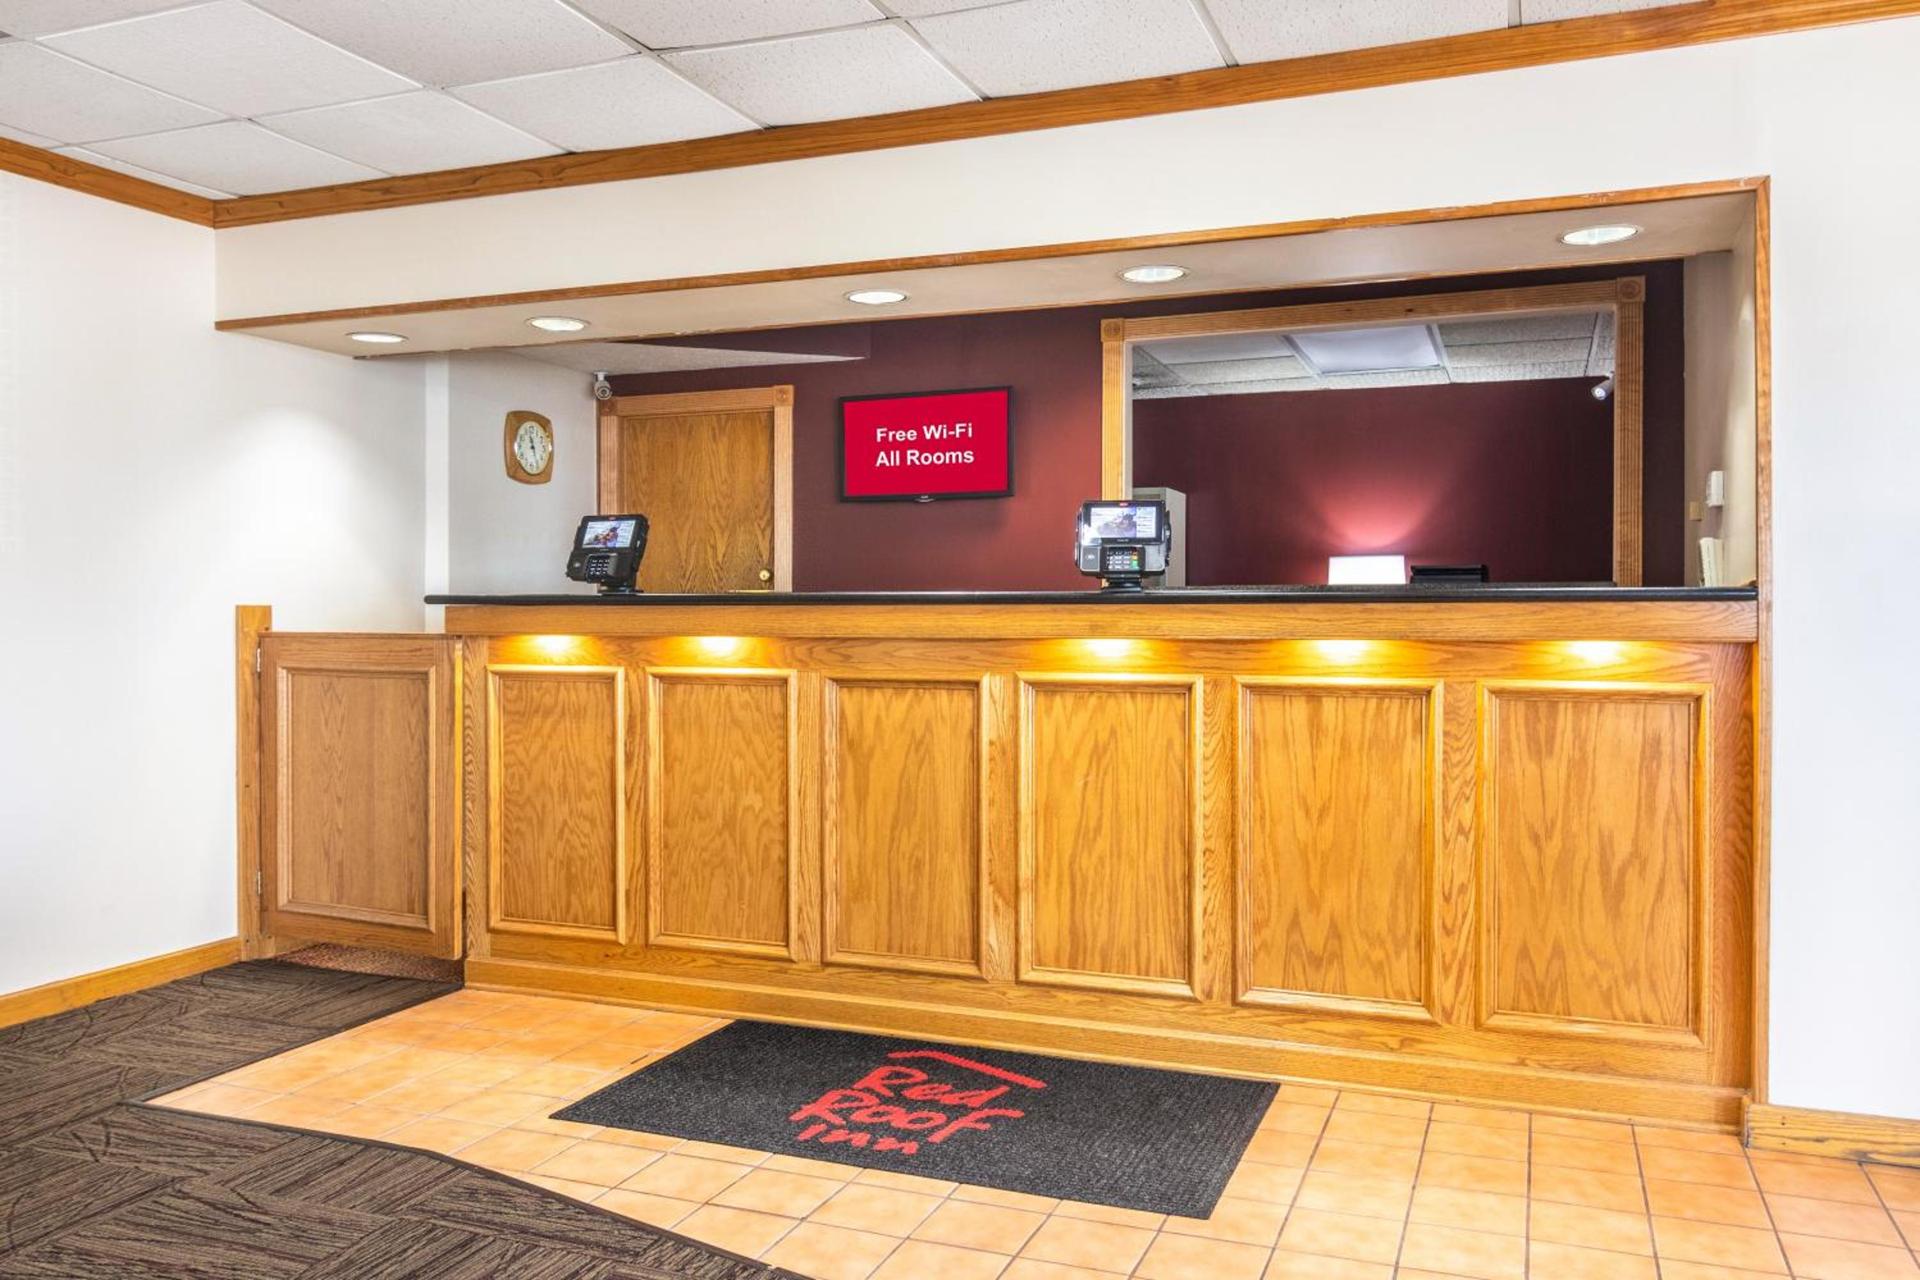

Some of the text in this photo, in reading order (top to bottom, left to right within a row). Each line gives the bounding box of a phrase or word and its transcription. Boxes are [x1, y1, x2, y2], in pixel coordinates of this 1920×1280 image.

[876, 422, 973, 443] Free Wi-Fi
[875, 449, 975, 467] All Rooms
[852, 1065, 1010, 1107] Red
[788, 1088, 1025, 1144] Roof
